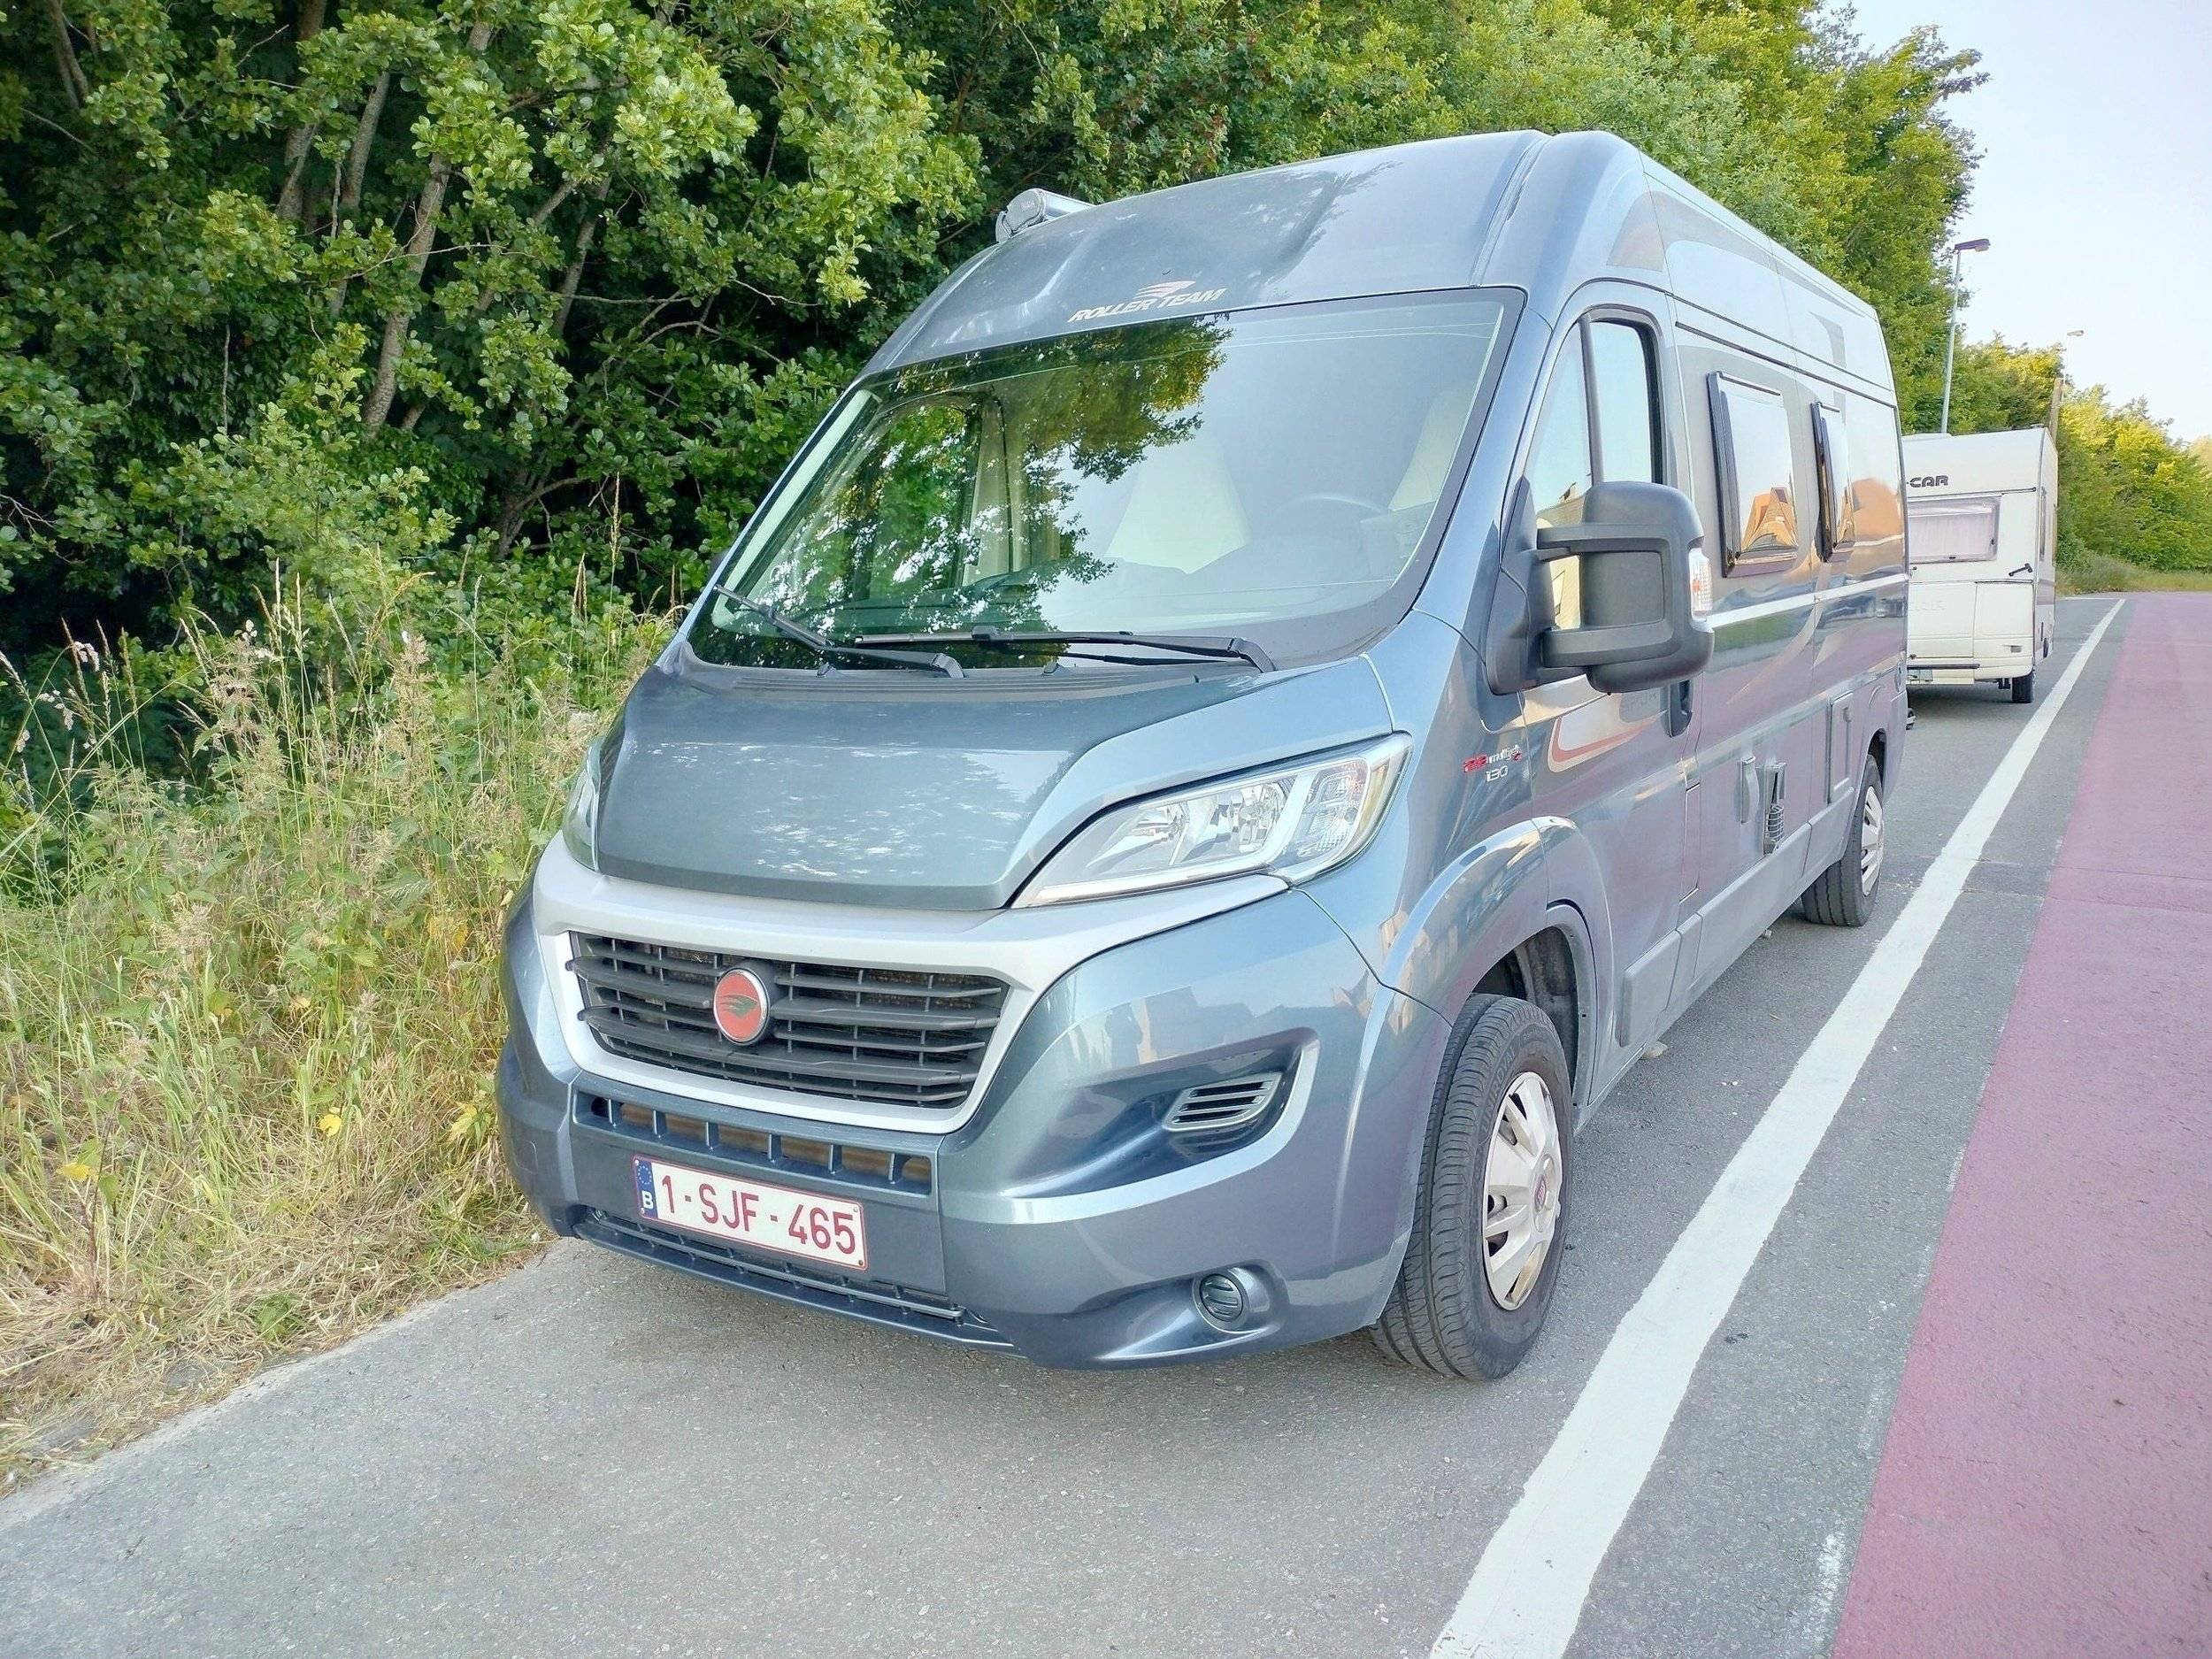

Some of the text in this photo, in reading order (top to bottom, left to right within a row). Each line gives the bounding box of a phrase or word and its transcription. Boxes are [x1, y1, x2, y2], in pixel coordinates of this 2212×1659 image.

[1067, 288, 1228, 322] ROLLER TEAM
[1486, 764, 1509, 782] 130
[641, 1190, 654, 1210] B
[661, 1174, 856, 1255] 1-SJF-465
